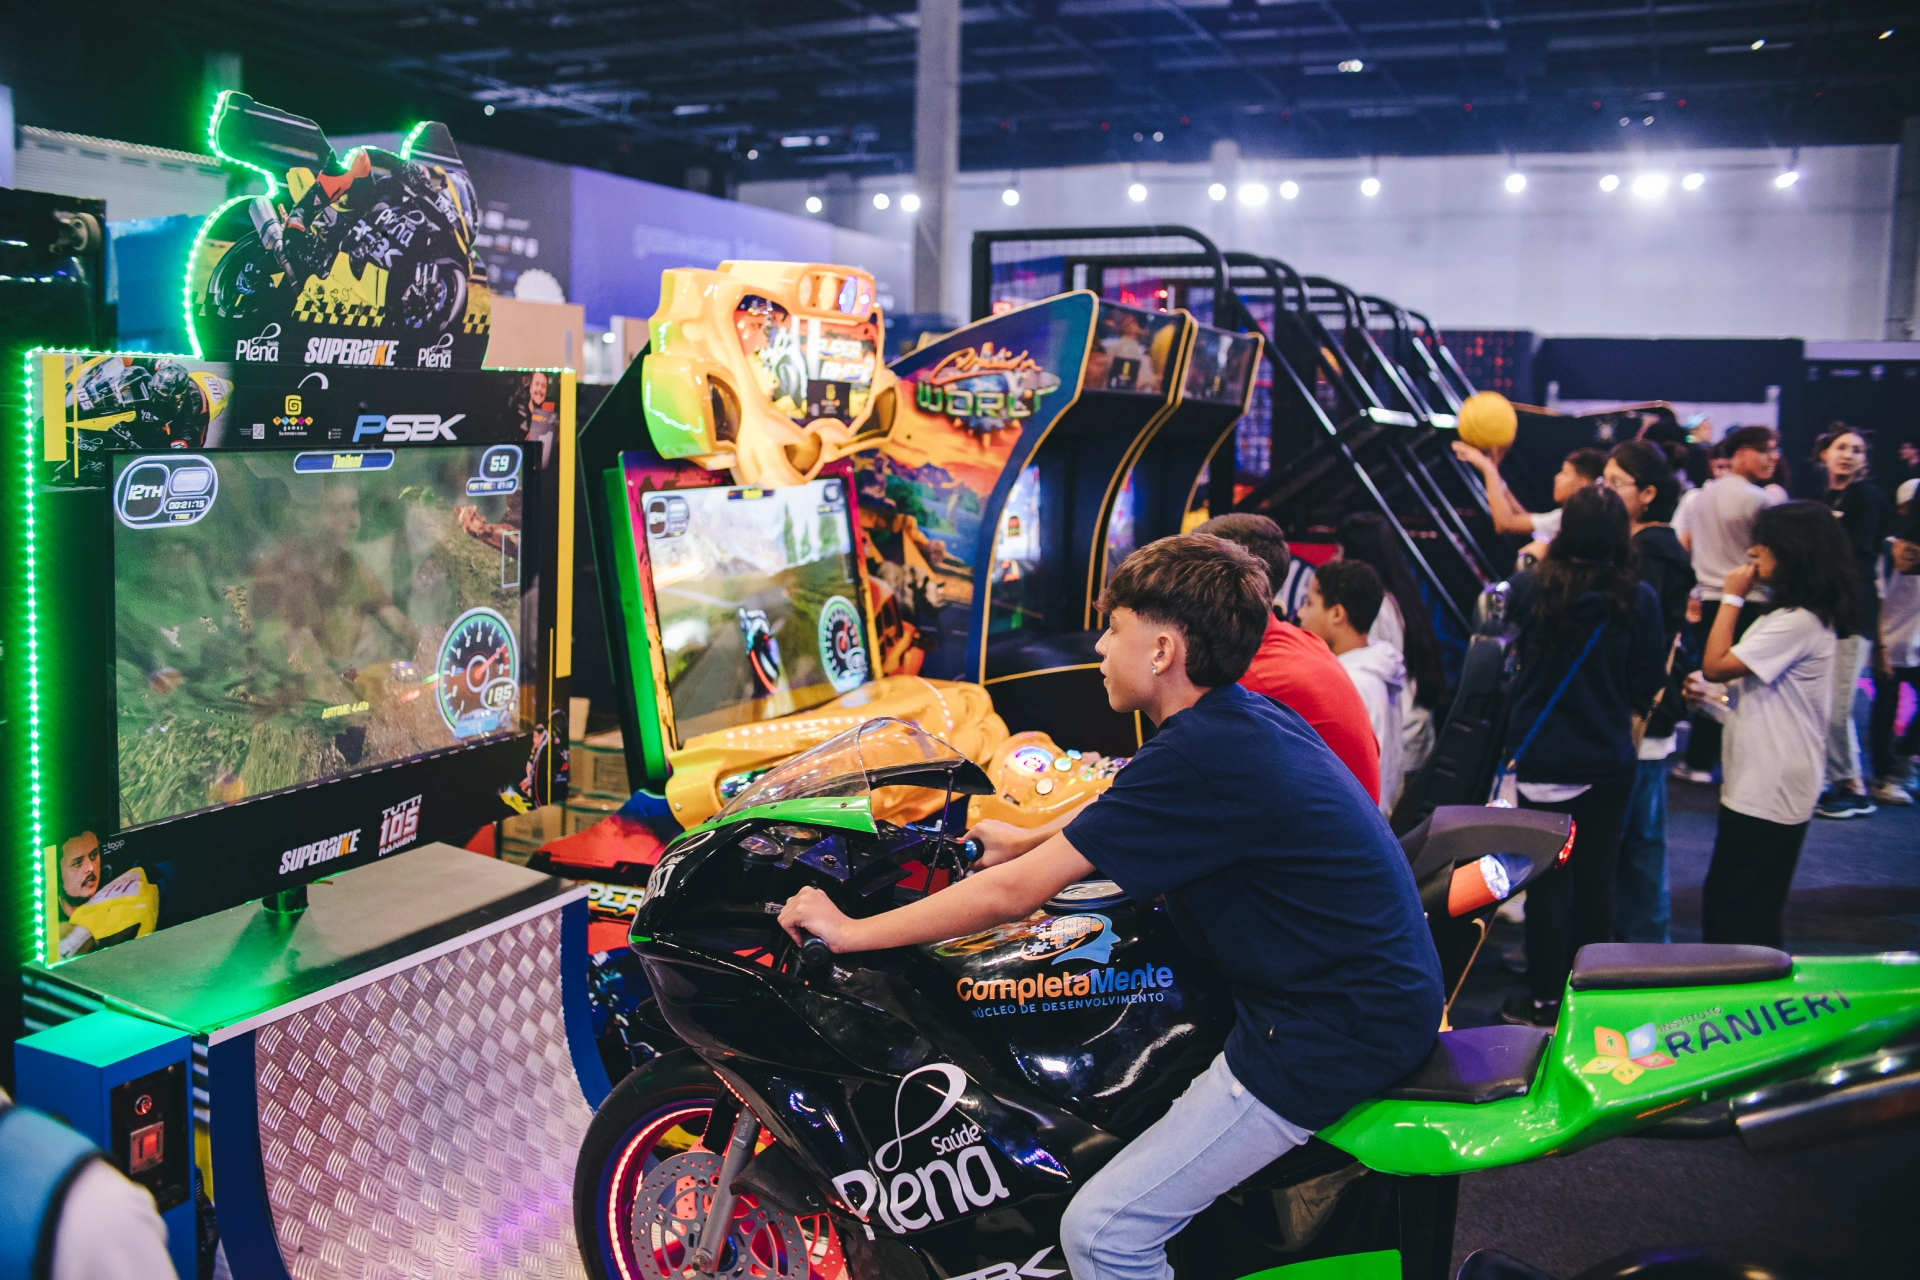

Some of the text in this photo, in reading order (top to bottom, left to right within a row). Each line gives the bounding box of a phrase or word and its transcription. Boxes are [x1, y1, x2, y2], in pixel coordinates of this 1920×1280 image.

[235, 339, 279, 362] Plena
[304, 337, 399, 366] SUPERBIKE
[417, 347, 452, 369] Plena
[352, 414, 466, 442] PSBK
[490, 455, 510, 472] 59
[128, 484, 164, 501] 12TH
[381, 794, 422, 819] TUTTI
[379, 804, 421, 849] 105
[279, 828, 361, 875] SUPERBIKE
[378, 833, 417, 857] RANIERI
[956, 962, 1174, 1005] CompletaMente
[972, 992, 1165, 1018] NÚCLEO DE DESENVOLVIMENTO
[1658, 1006, 1723, 1034] INSTITUTO
[1664, 989, 1850, 1058] RANIERI
[931, 1123, 982, 1156] Saúde
[831, 1145, 1010, 1241] Plena
